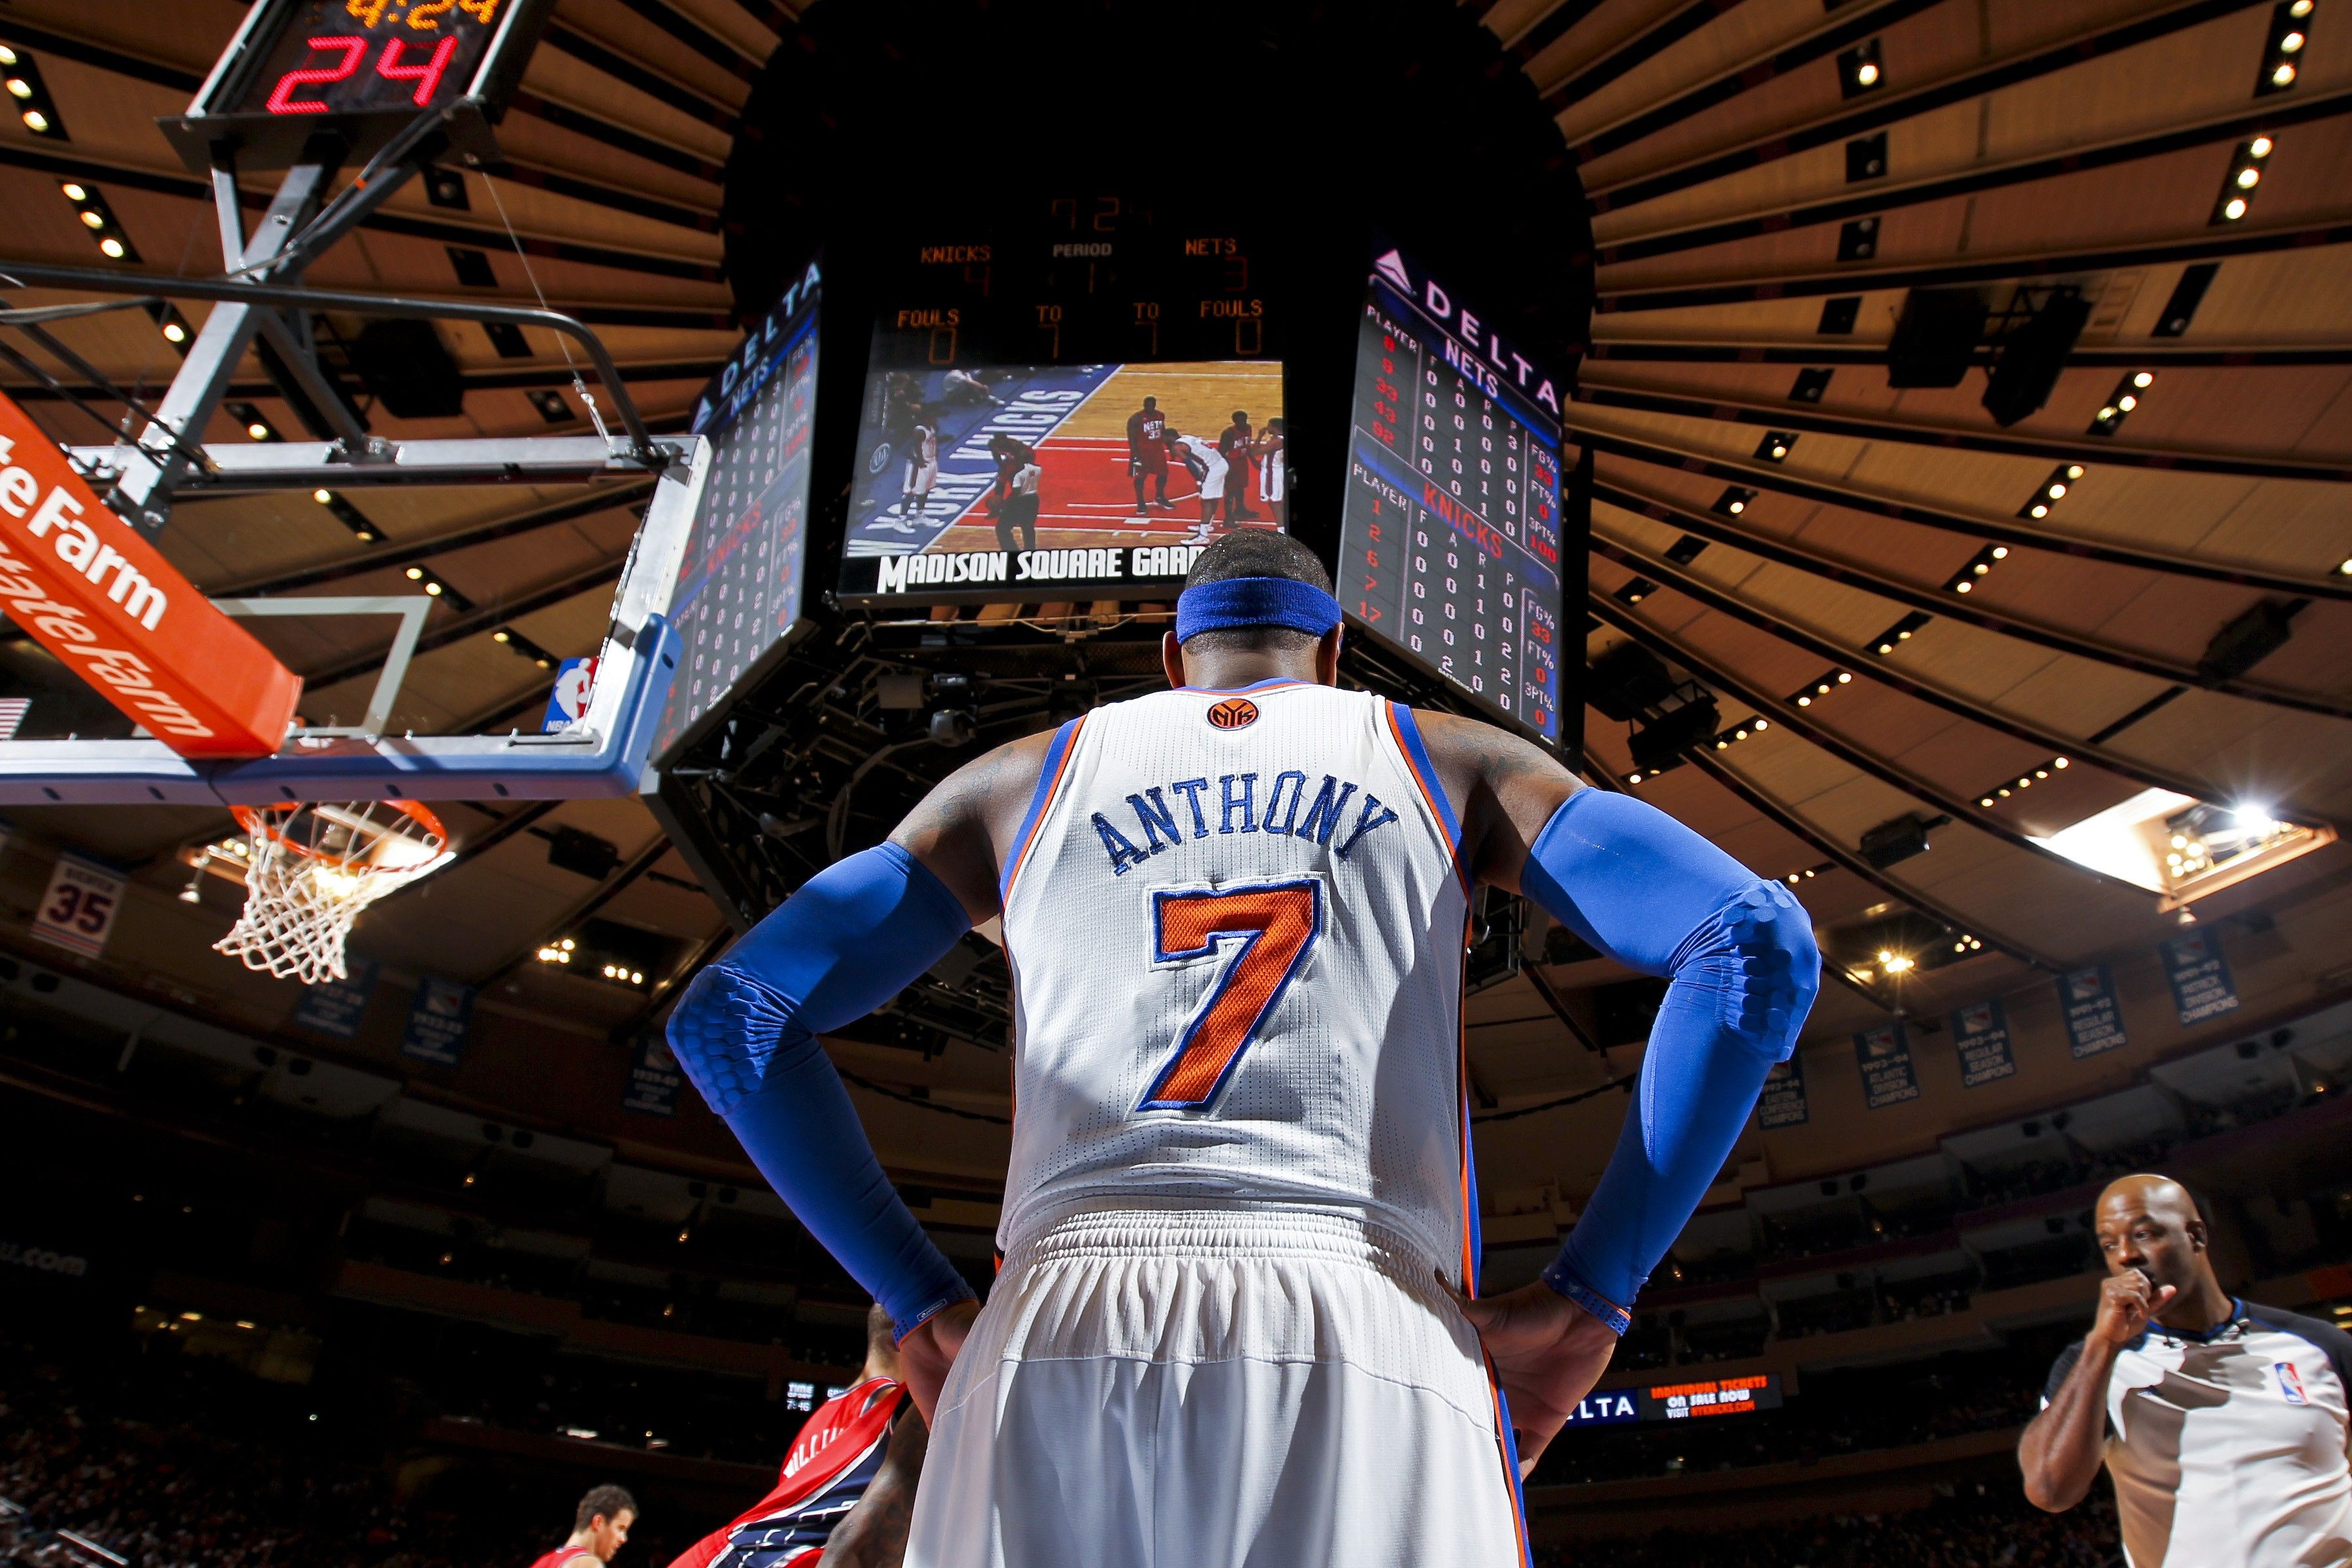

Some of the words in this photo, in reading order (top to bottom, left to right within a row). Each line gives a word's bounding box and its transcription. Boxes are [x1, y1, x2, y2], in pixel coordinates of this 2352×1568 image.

[265, 35, 458, 115] 24
[920, 244, 992, 265] KNICKS
[1052, 242, 1113, 259] PERIOD
[1184, 238, 1237, 256] NETS
[964, 265, 991, 297] 4
[1223, 255, 1249, 292] 3
[897, 308, 960, 328] FOULS
[1035, 304, 1063, 323] TO
[1133, 302, 1160, 320] TO
[1200, 299, 1263, 319] FOULS
[721, 263, 821, 397] DELTA
[1235, 318, 1263, 355] 0
[1366, 304, 1418, 353] PLAYER
[928, 327, 958, 365] 0
[1426, 279, 1560, 416] DELTA
[1445, 337, 1499, 399] NETS
[730, 355, 770, 417] NETS
[1426, 370, 1437, 386] 0
[1454, 393, 1465, 408] 0
[1482, 415, 1493, 430] 0
[1507, 434, 1518, 450] 3
[1425, 393, 1437, 408] 0
[1454, 415, 1465, 430] 0
[1481, 436, 1492, 453] 0
[1507, 456, 1517, 472] 0
[1424, 414, 1435, 431] 0
[1454, 438, 1462, 453] 1
[1480, 459, 1491, 475] 0
[1506, 478, 1516, 495] 0
[1531, 444, 1557, 473] FG%
[1353, 463, 1407, 511] PLAYER
[1422, 436, 1434, 452] 0
[1452, 458, 1463, 475] 0
[1481, 481, 1489, 496] 1
[1505, 499, 1516, 515] 0
[1421, 458, 1433, 474] 0
[1450, 480, 1462, 496] 0
[1480, 502, 1488, 517] 1
[1505, 520, 1516, 537] 0
[1531, 479, 1556, 509] FT%
[1424, 482, 1502, 559] KNICKS
[1528, 516, 1556, 546] 3PT%
[707, 501, 763, 578] KNICKS
[1373, 498, 1381, 515] 1
[1416, 531, 1428, 547] 0
[1447, 552, 1458, 569] 0
[1478, 574, 1485, 589] 1
[1503, 593, 1513, 609] 0
[1420, 509, 1428, 523] F
[1448, 532, 1458, 547] A
[1478, 551, 1486, 567] R
[1506, 572, 1514, 585] P
[1530, 534, 1558, 563] 100
[876, 551, 1007, 594] MADISON
[1015, 548, 1123, 580] SQUARE
[1369, 523, 1381, 542] 2
[1415, 556, 1427, 573] 0
[1446, 577, 1457, 594] 0
[1477, 598, 1484, 615] 1
[1502, 617, 1512, 633] 0
[1366, 549, 1379, 568] 6
[1414, 581, 1426, 598] 0
[1445, 602, 1456, 620] 0
[1475, 623, 1485, 640] 0
[1502, 642, 1512, 659] 2
[1527, 599, 1555, 630] FG%
[1364, 575, 1377, 591] 7
[1412, 608, 1424, 625] 0
[1443, 629, 1454, 646] 0
[1475, 649, 1482, 666] 1
[1501, 667, 1511, 685] 2
[1531, 621, 1551, 644] 33
[1359, 600, 1382, 622] 17
[1411, 634, 1422, 653] 0
[1442, 655, 1453, 674] 2
[1472, 675, 1483, 692] 0
[1500, 693, 1511, 710] 0
[1527, 639, 1554, 670] FT%
[1535, 666, 1546, 683] 0
[1212, 700, 1257, 727] NYK
[1525, 682, 1554, 711] 3PT%
[1535, 708, 1546, 725] 0
[1091, 770, 1399, 877] ANTHONY
[49, 885, 112, 934] 35
[1129, 875, 1326, 1117] 7
[2181, 996, 2240, 1023] CHAMPIONS
[2074, 1032, 2126, 1057] CHAMPIONS
[1965, 1062, 2014, 1086] CHAMPIONS
[1870, 1086, 1918, 1107] CHAMPIONS
[1650, 1382, 1718, 1399] INDIVIDUAL
[1719, 1375, 1767, 1391] TICKETS
[1667, 1395, 1686, 1408] ON
[1690, 1392, 1716, 1407] SALE
[1719, 1388, 1750, 1403] NOW
[1567, 1396, 1634, 1420] LTA
[1666, 1407, 1689, 1419] VISIT
